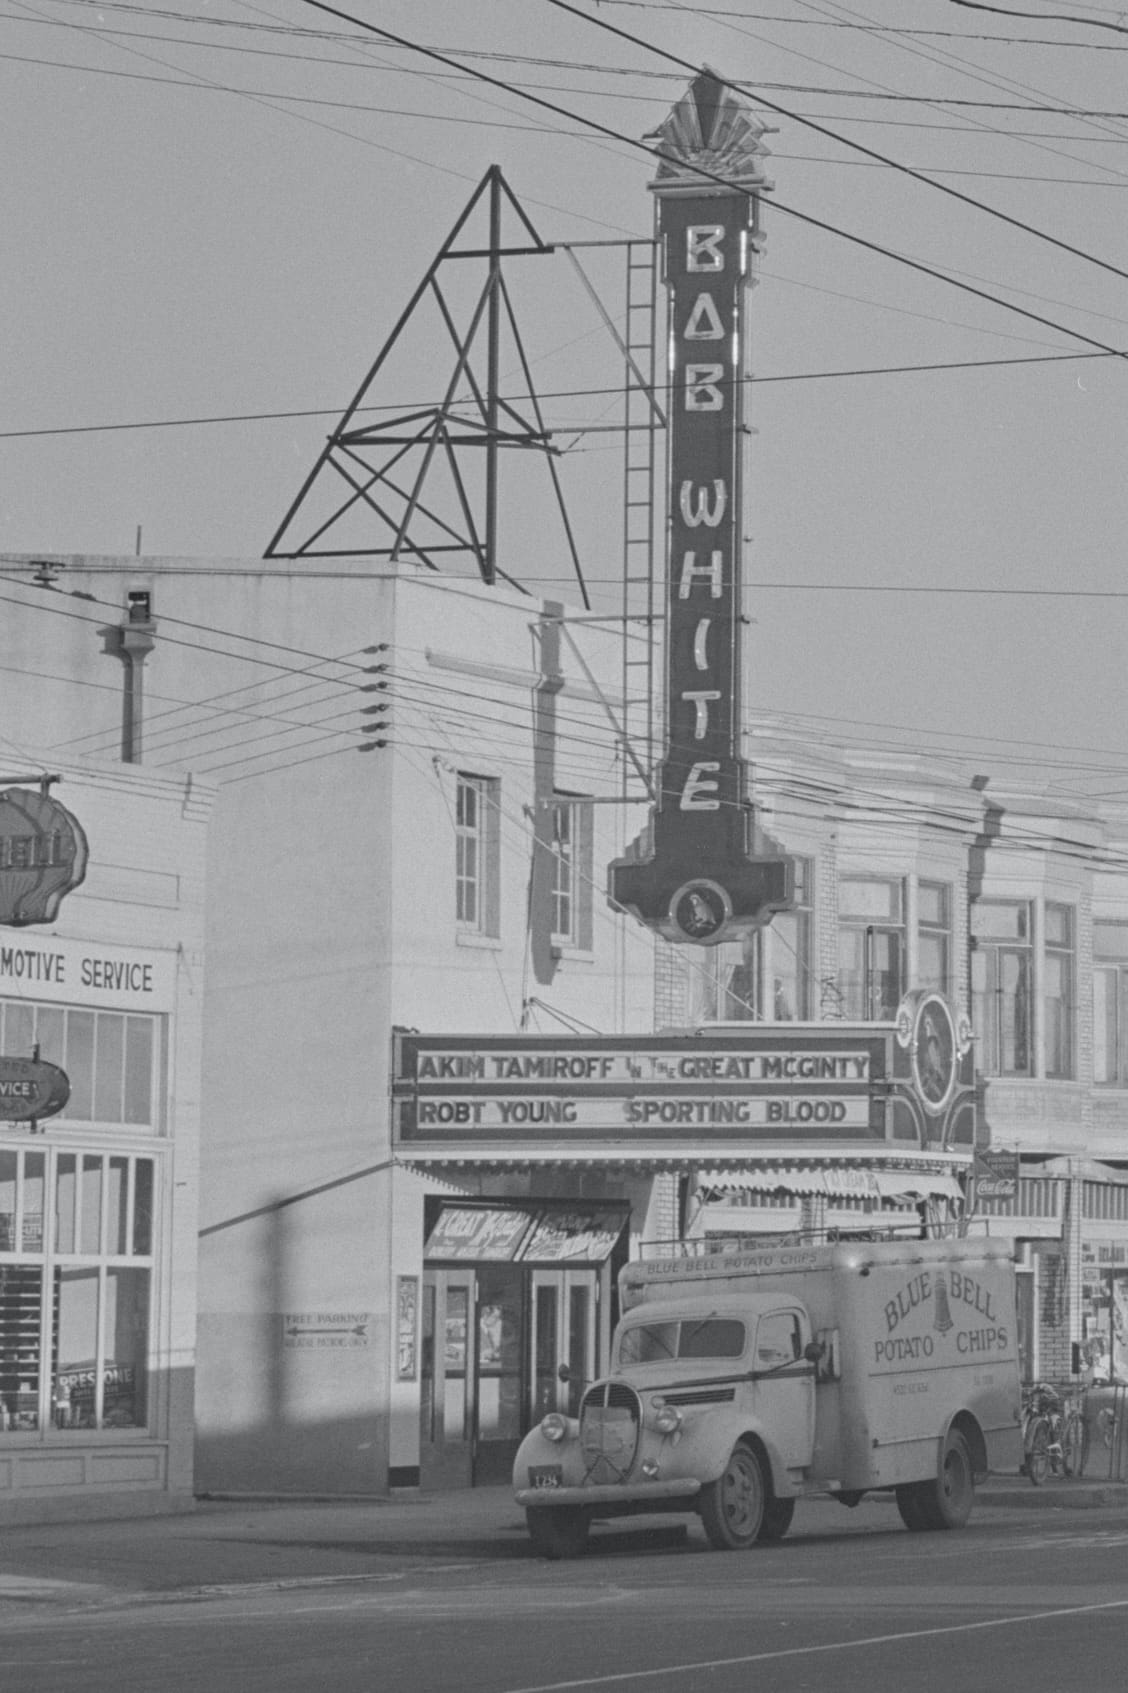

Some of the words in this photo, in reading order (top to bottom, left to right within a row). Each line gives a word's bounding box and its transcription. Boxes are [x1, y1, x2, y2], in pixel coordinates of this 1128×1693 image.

[678, 479, 728, 812] WHITE
[81, 958, 153, 992] SERVICE
[419, 1056, 485, 1078] AKIM
[492, 1056, 615, 1078] TAMIROFF
[648, 1056, 676, 1079] THE
[680, 1056, 755, 1078] GREAT
[761, 1056, 870, 1078] MCGINTY
[419, 1101, 486, 1123] ROBT
[496, 1101, 578, 1123] YOUNG
[625, 1101, 751, 1124] SPORTING
[766, 1101, 847, 1123] BLOOD
[647, 1262, 681, 1275] BLUE
[685, 1260, 718, 1272] BELL
[724, 1255, 774, 1269] POTATO
[780, 1252, 818, 1265] CHIPS
[884, 1271, 932, 1333] BLUE
[950, 1270, 996, 1322] BELL
[874, 1335, 934, 1363] POTATO
[956, 1326, 1008, 1354] CHIPS
[59, 1369, 133, 1389] PRESONE
